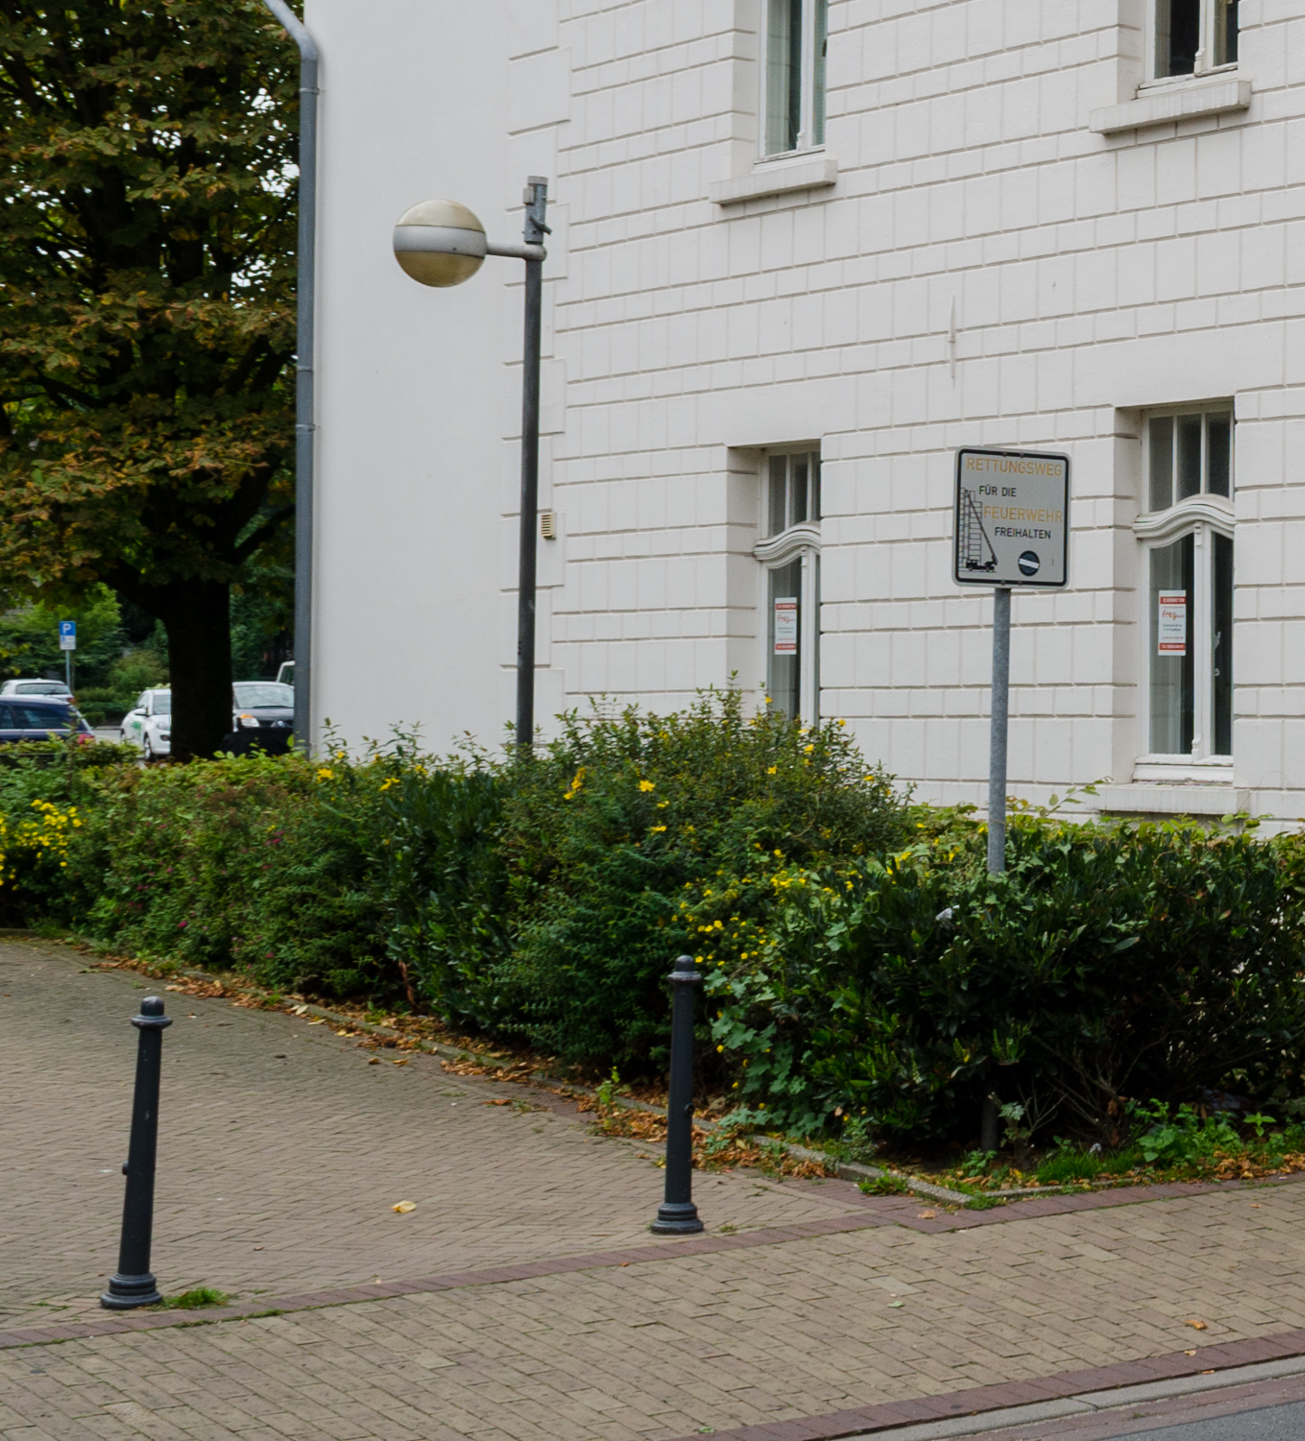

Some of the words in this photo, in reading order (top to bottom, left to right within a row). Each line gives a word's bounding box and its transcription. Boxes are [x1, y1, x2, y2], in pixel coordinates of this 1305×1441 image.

[966, 456, 1063, 477] RETTUNGSWEG
[979, 484, 998, 496] FÜR
[1001, 486, 1017, 498] DIE
[983, 505, 1063, 524] FEUERWEHR
[994, 526, 1052, 539] FREIHALTEN
[63, 623, 72, 635] P
